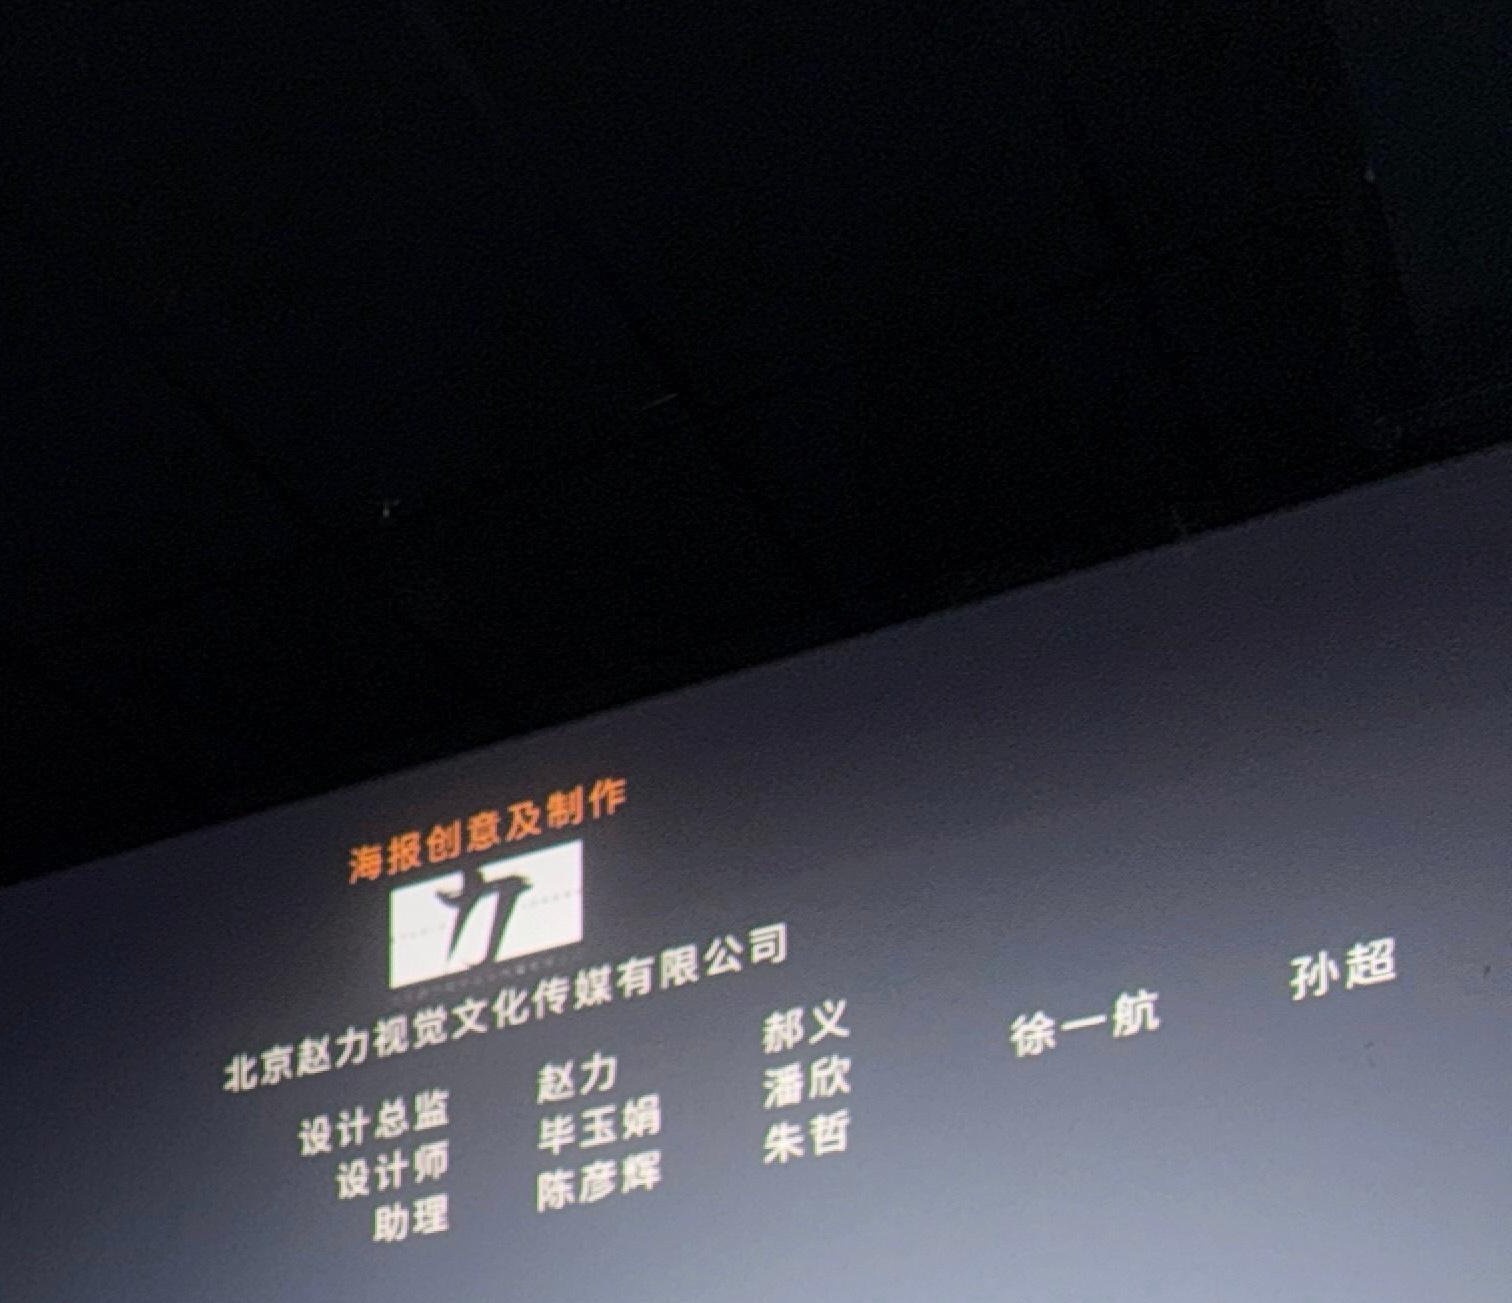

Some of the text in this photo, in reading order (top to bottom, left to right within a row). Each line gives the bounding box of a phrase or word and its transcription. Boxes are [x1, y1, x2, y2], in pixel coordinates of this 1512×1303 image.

[347, 776, 628, 885] 海报创意及制作
[223, 921, 789, 1094] 北京赵力视觉文化传媒有限公司
[297, 998, 851, 1157] 设计总监 赵力 郝义
[336, 936, 1397, 1200] 设计师 毕玉娟 潘欣 徐一航 孙超
[373, 1109, 851, 1243] 助理 陈彦辉 朱哲
